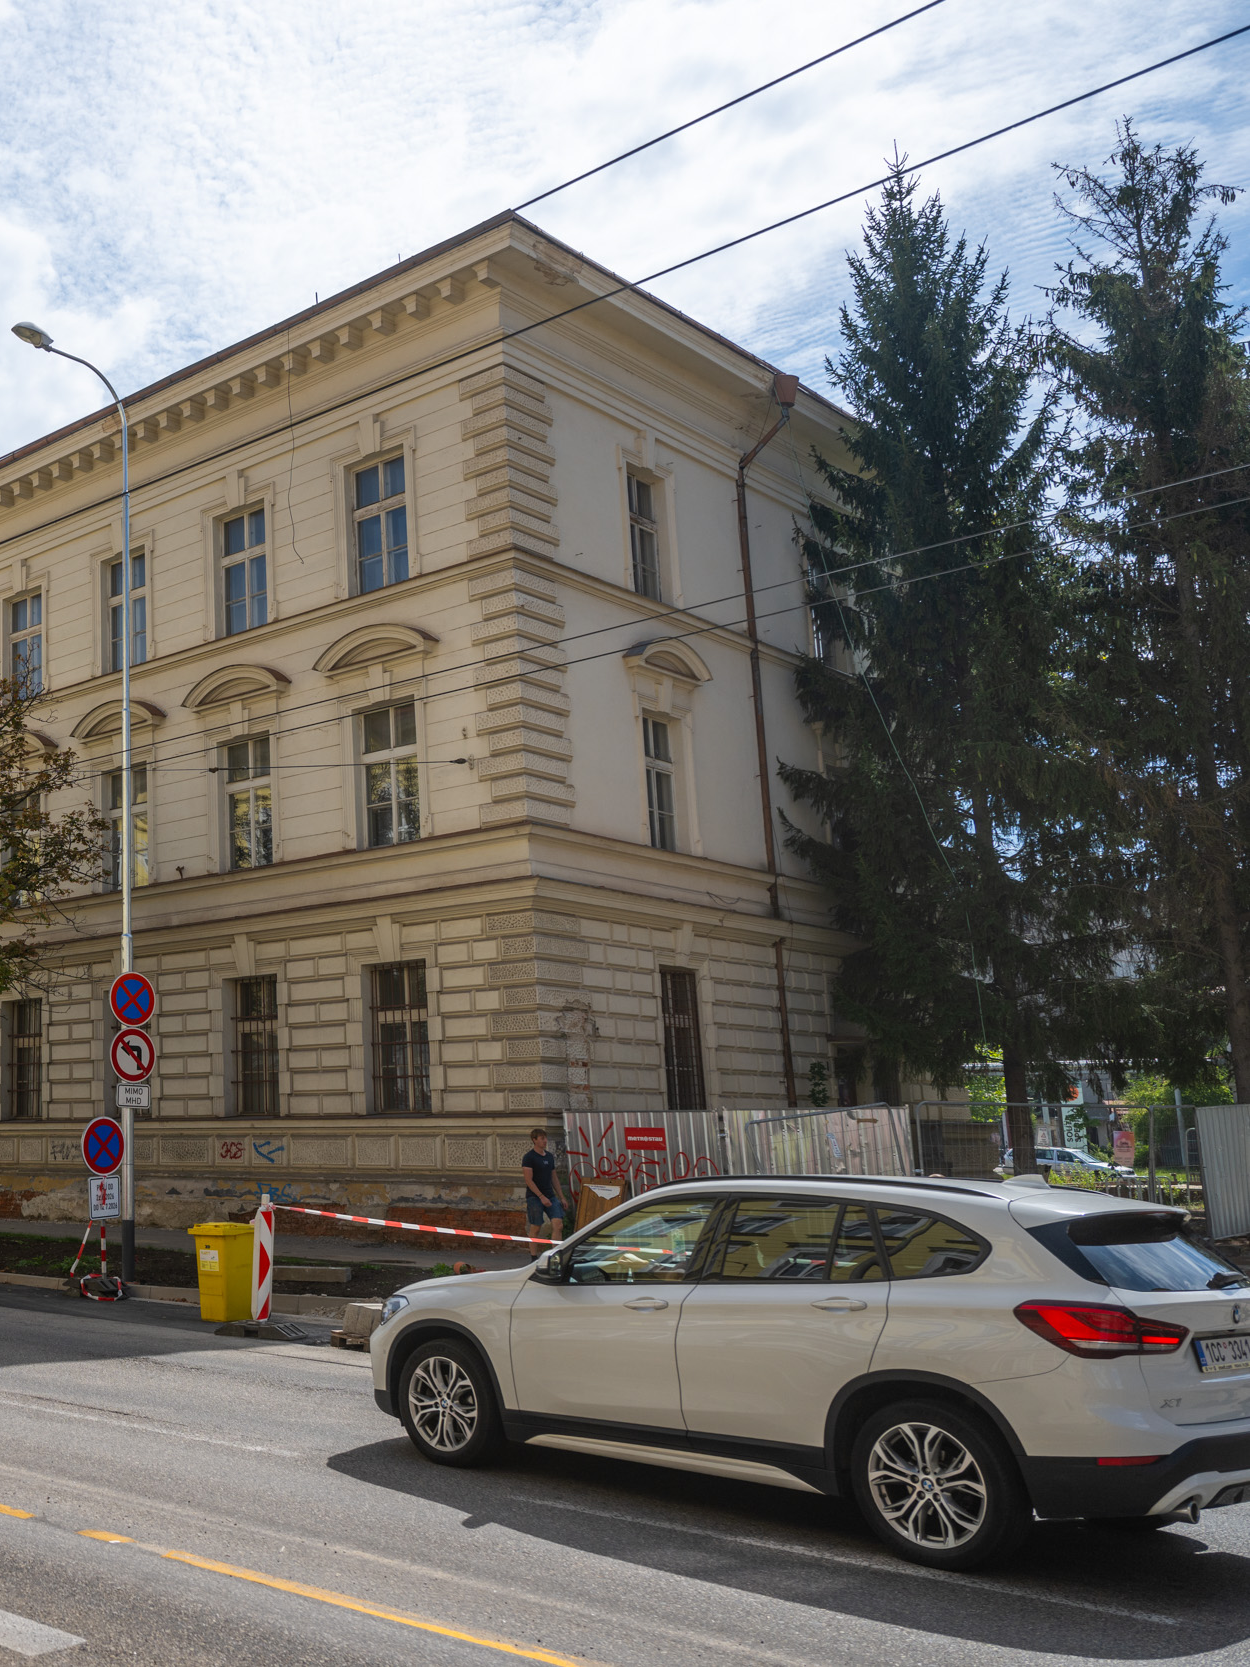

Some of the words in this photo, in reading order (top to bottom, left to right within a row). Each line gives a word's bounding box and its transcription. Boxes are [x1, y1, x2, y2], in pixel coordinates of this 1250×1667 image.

[124, 1087, 143, 1096] MIMO
[125, 1096, 142, 1105] MHD
[1205, 1341, 1226, 1363] 1CC
